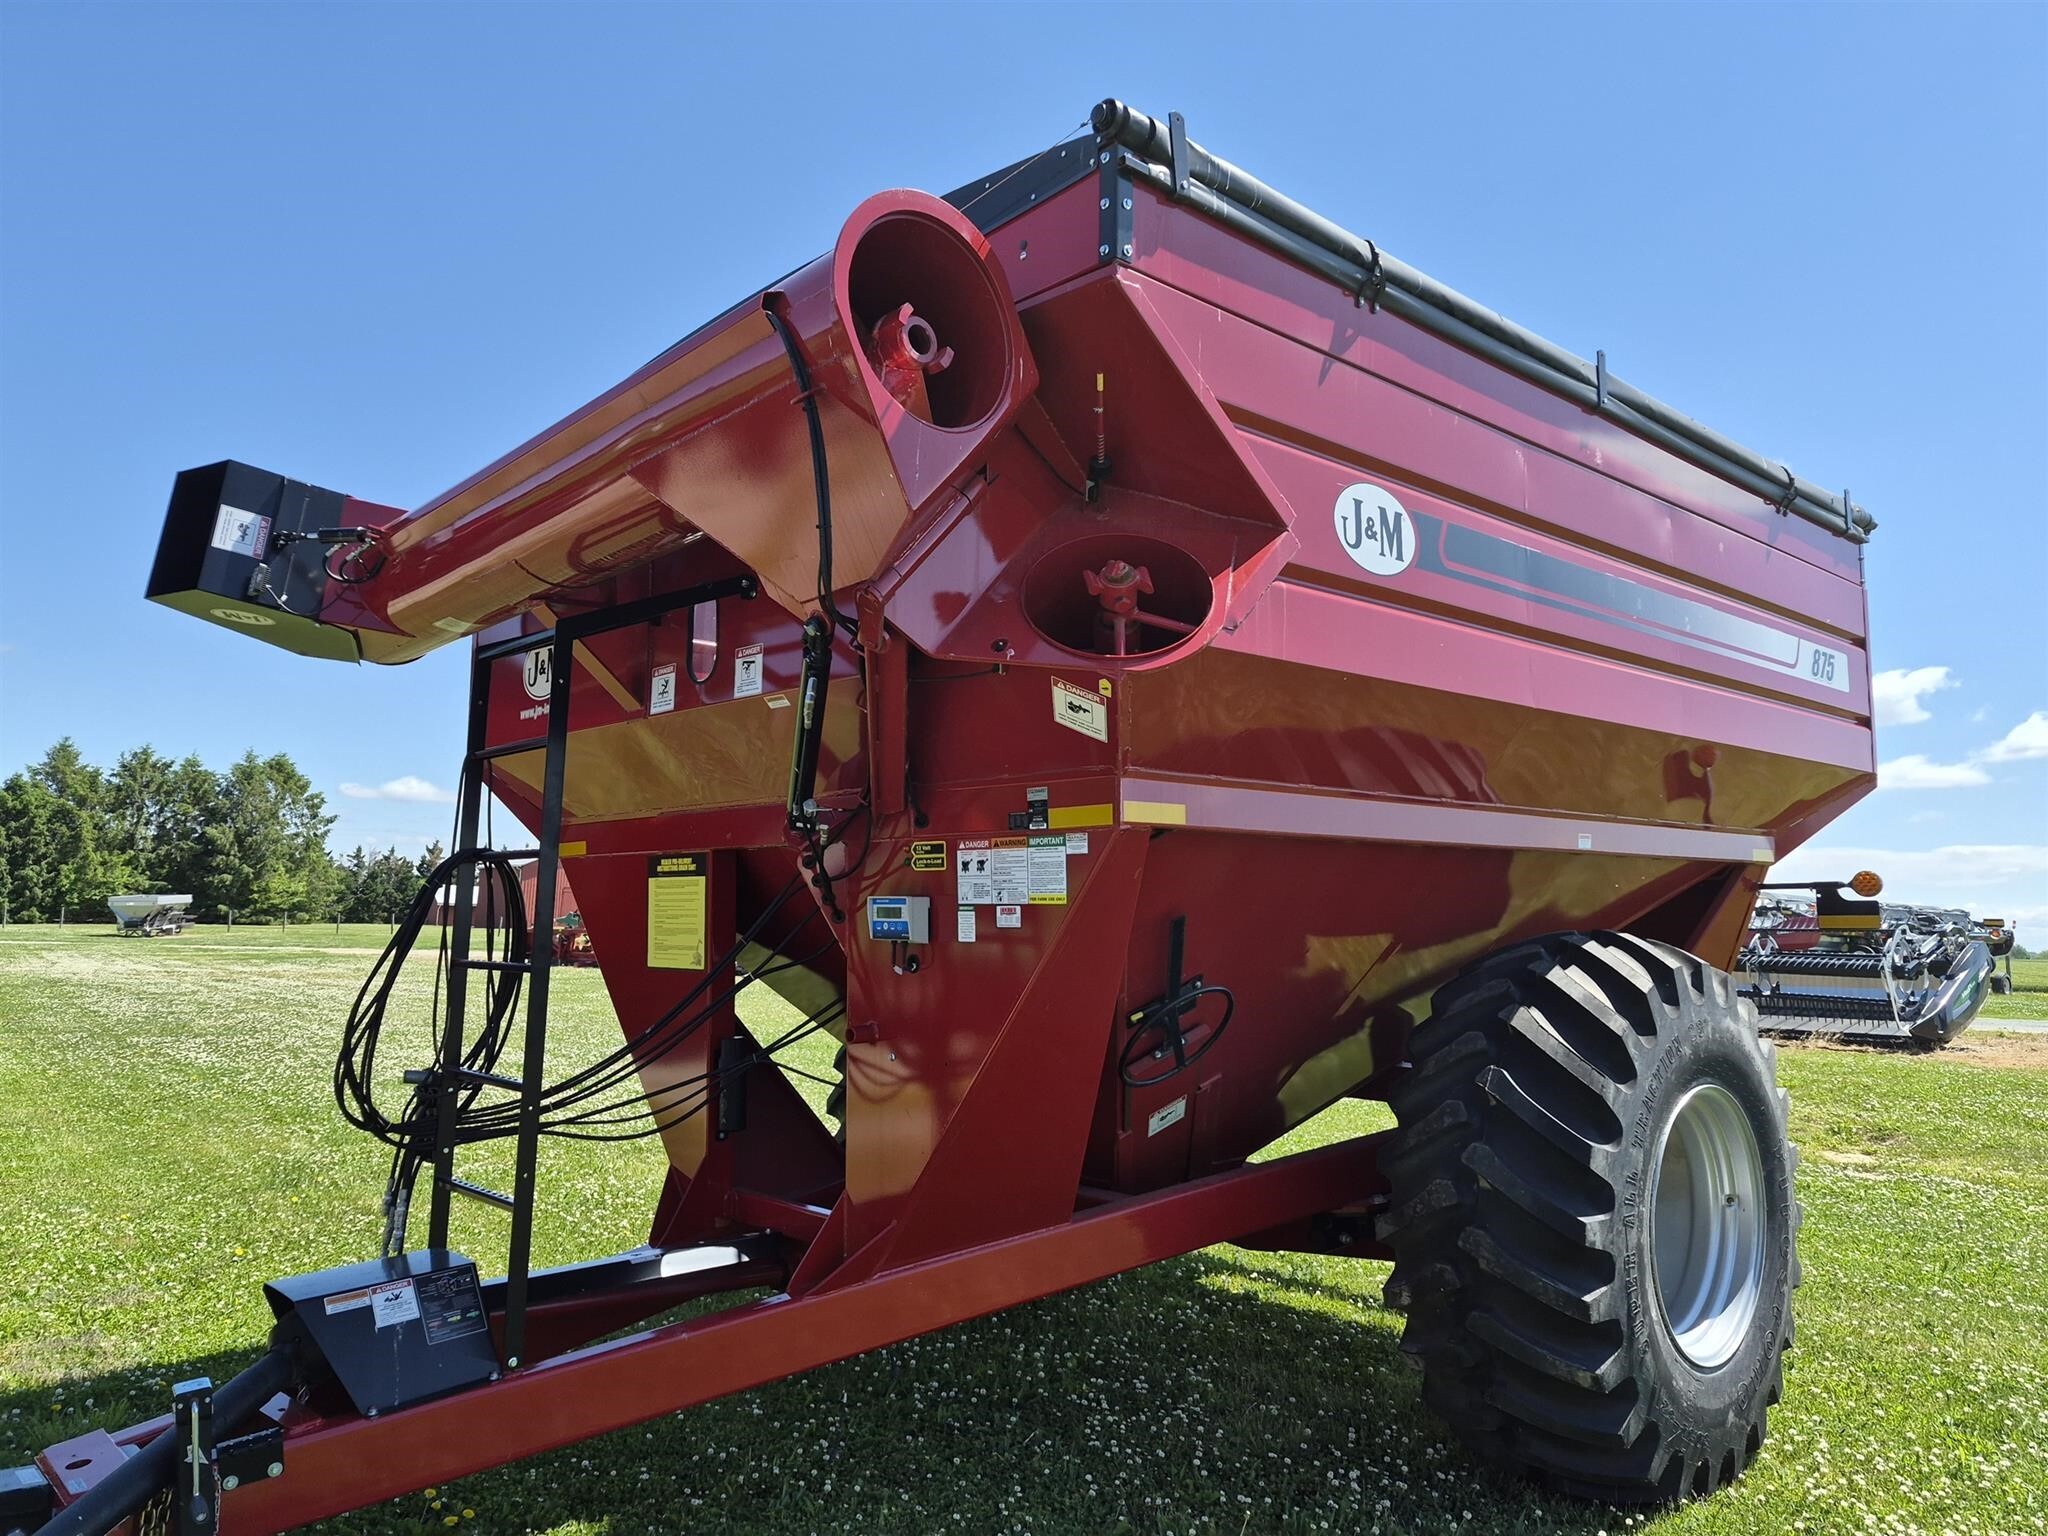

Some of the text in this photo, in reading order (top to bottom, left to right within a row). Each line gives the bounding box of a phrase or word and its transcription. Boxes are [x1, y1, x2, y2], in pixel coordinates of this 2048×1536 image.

[1340, 497, 1404, 562] J&M
[1812, 648, 1835, 682] 875
[1065, 685, 1101, 704] DANGER
[965, 840, 989, 849] DANGER
[1000, 838, 1026, 848] WARNING
[1029, 836, 1064, 846] IMPORTANT
[1630, 1033, 1684, 1150] TRACTION
[1622, 1169, 1640, 1230] ALL
[381, 1280, 409, 1292] DANGER
